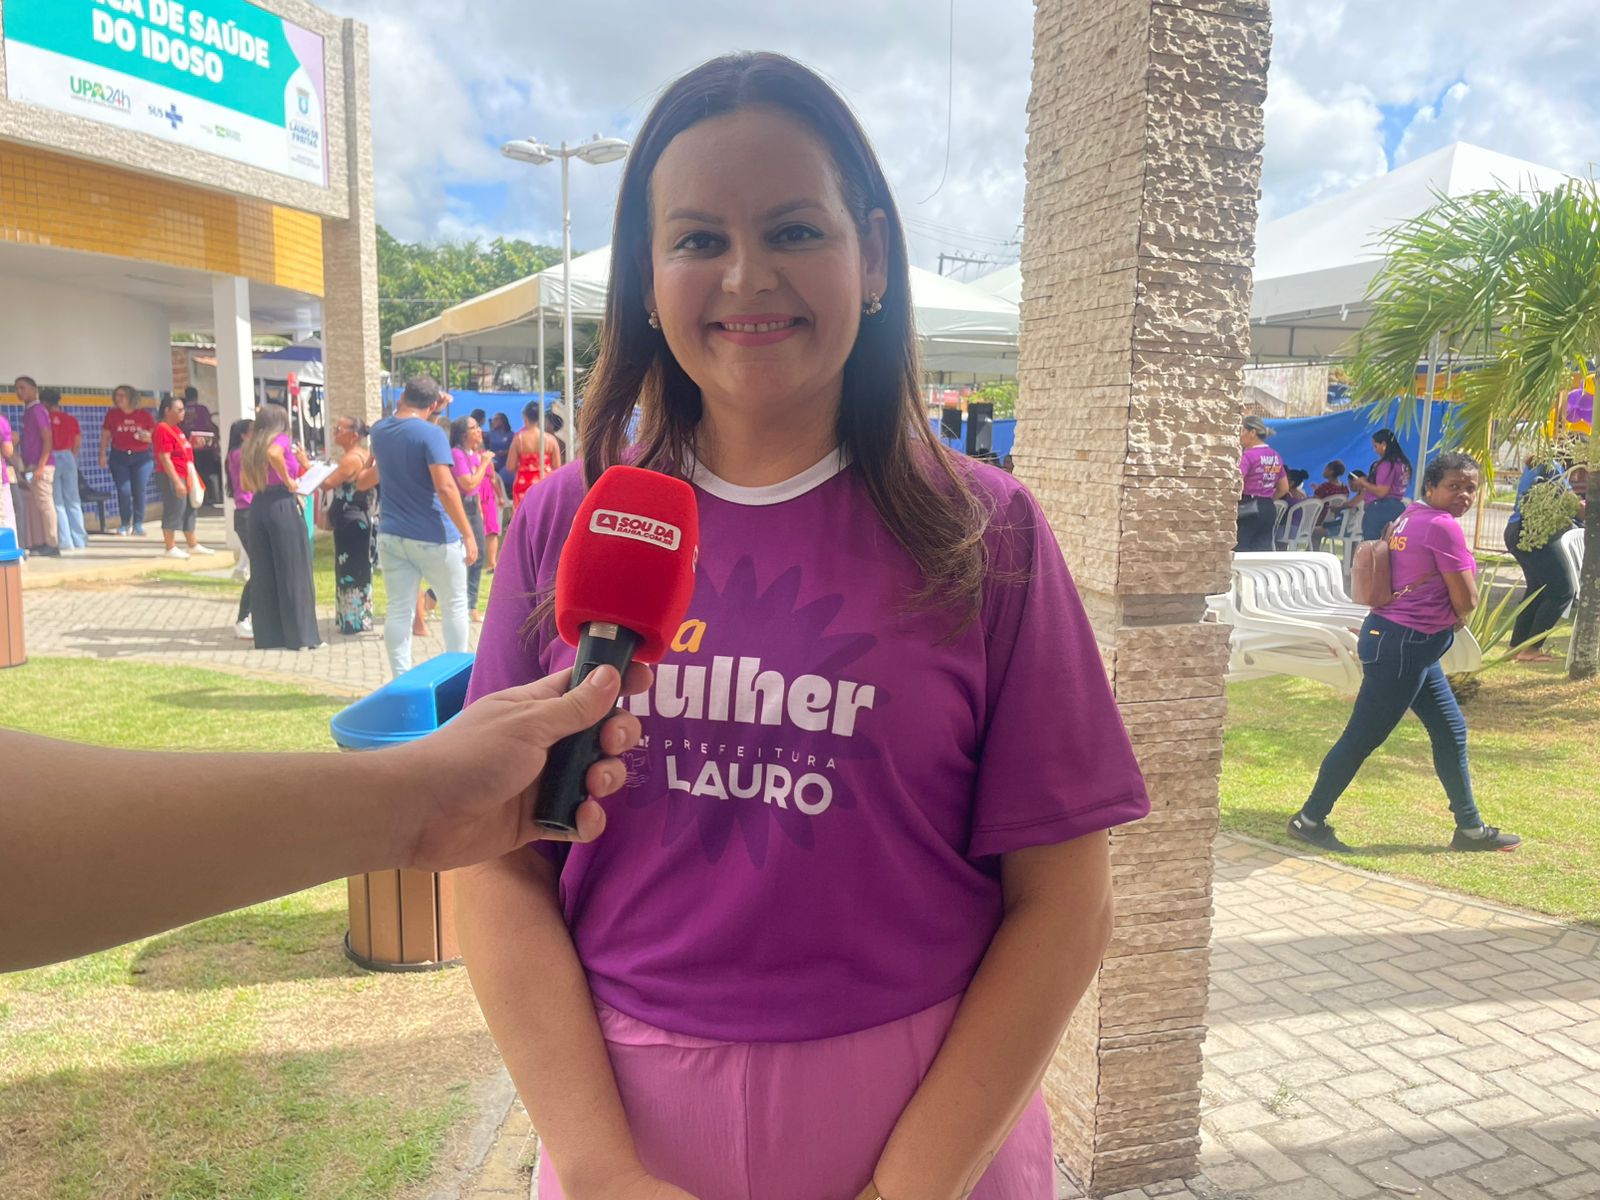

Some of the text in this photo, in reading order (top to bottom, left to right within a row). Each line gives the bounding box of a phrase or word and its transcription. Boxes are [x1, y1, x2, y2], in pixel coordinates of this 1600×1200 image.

[92, 8, 224, 83] DO IDOSO
[149, 0, 270, 69] DE SAÚDE
[618, 516, 674, 541] SOU DA
[664, 739, 836, 770] PREFEITURA
[665, 754, 834, 816] LAURO
